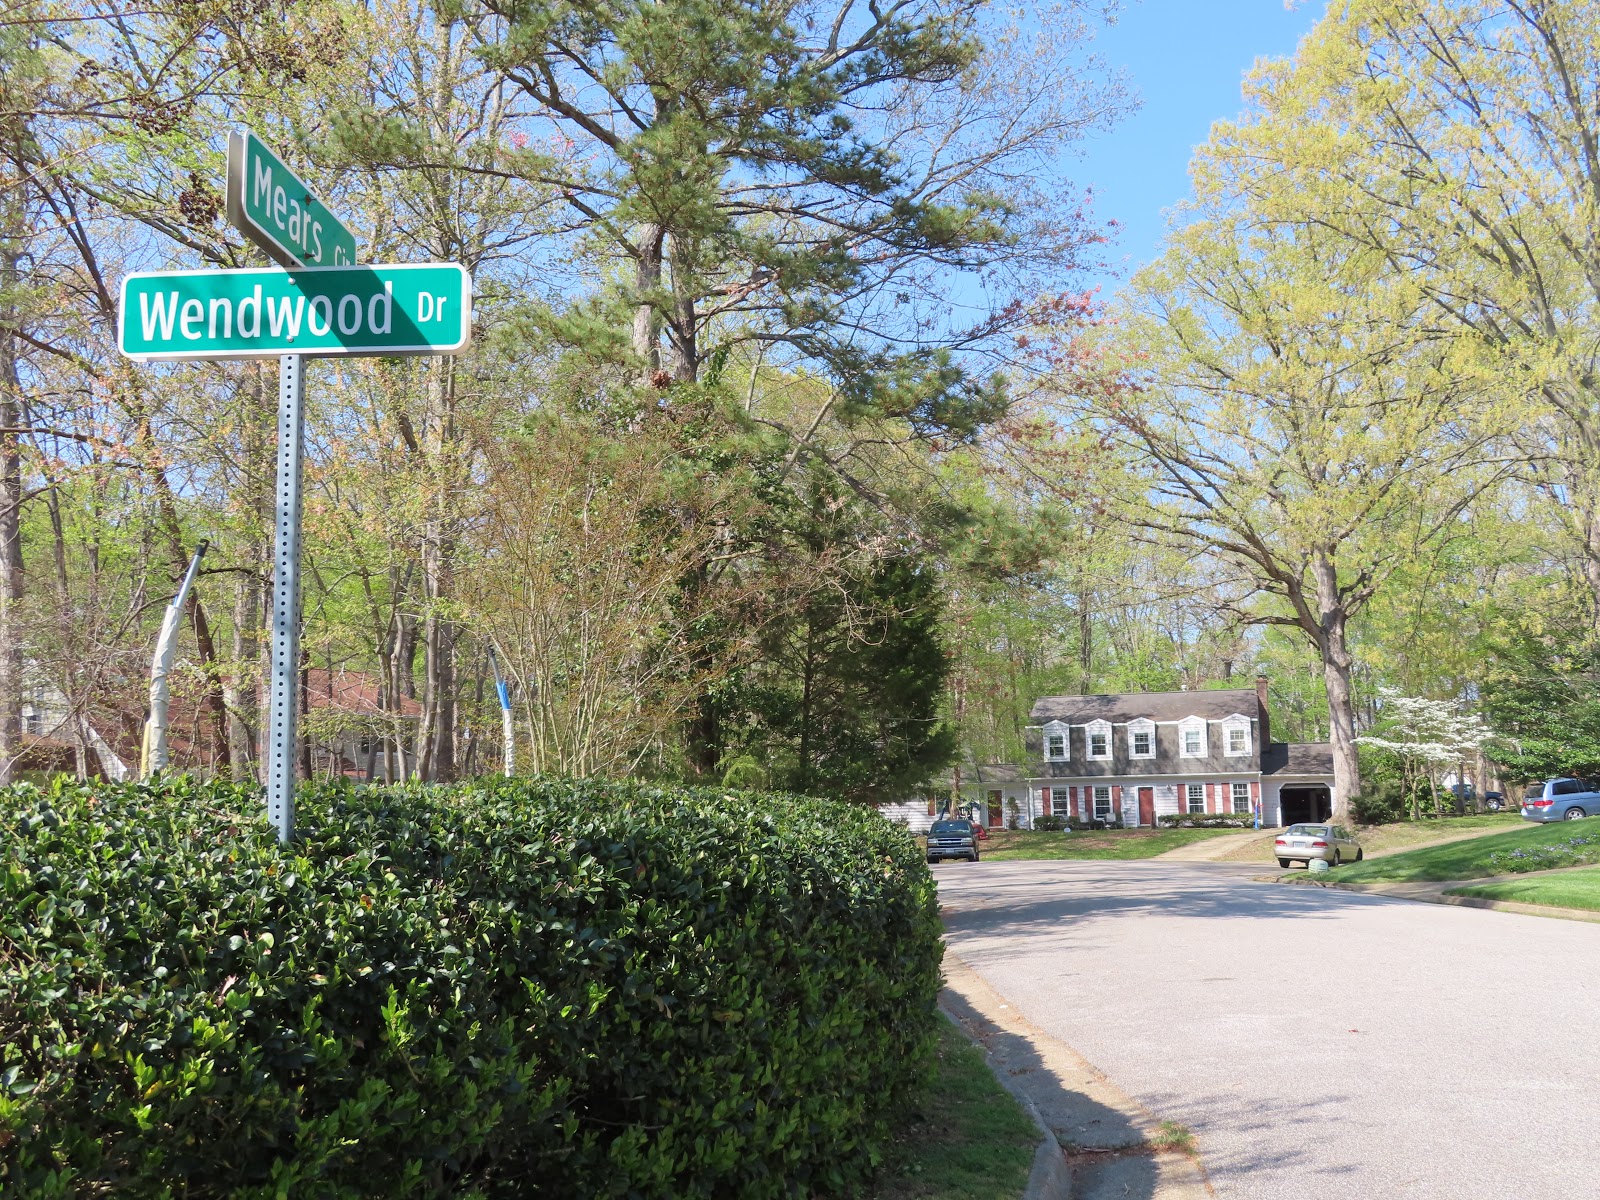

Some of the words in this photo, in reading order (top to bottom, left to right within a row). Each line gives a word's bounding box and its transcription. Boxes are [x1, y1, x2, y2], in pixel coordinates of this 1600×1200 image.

[254, 154, 323, 263] Mears
[139, 281, 393, 342] Wendwood
[417, 291, 447, 322] Dr
